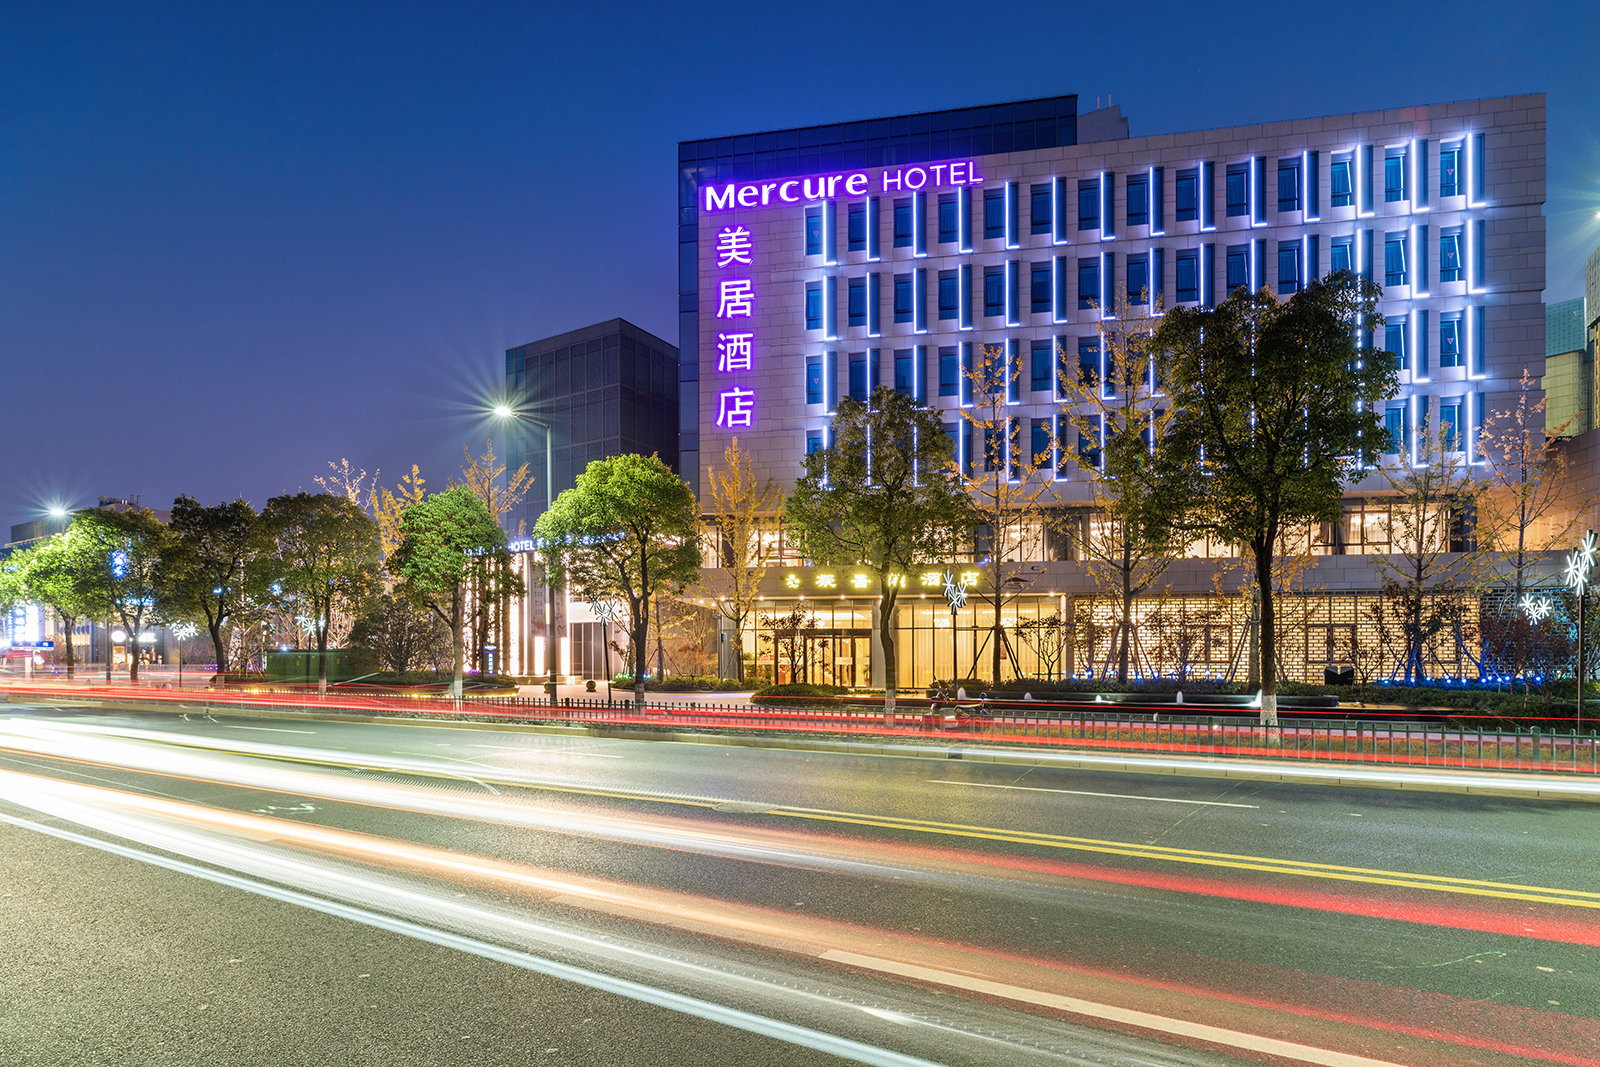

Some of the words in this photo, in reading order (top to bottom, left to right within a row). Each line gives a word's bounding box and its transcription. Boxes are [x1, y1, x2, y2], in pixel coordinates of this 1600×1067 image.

[705, 173, 868, 211] Mercure
[883, 161, 984, 191] HOTEL
[716, 226, 755, 428] 美居酒店
